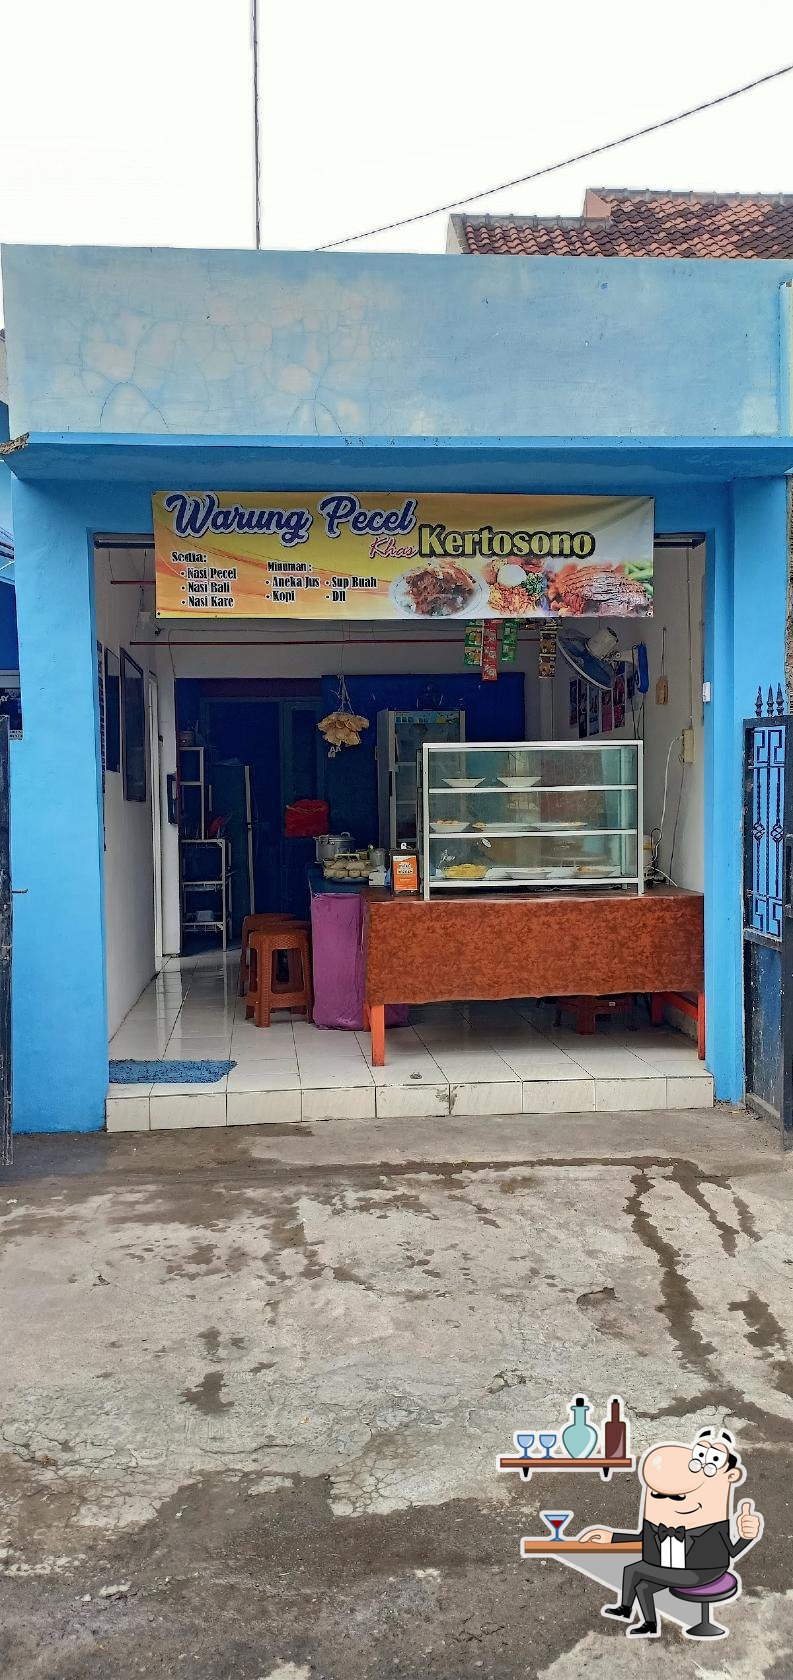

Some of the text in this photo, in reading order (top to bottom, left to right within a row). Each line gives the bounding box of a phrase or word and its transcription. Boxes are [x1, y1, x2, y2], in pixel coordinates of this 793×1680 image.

[165, 493, 417, 546] Warung Pecel
[369, 524, 595, 559] Khas Kertosono
[171, 551, 207, 563] Sedia:
[267, 561, 307, 572] Minuman
[187, 568, 237, 579] Nasi Pecel
[188, 582, 208, 593] Nasi
[272, 576, 320, 589] Aneka Jus
[331, 576, 377, 589] Sup Buah
[188, 596, 234, 607] Nasi Kare
[272, 590, 295, 602] Kopi
